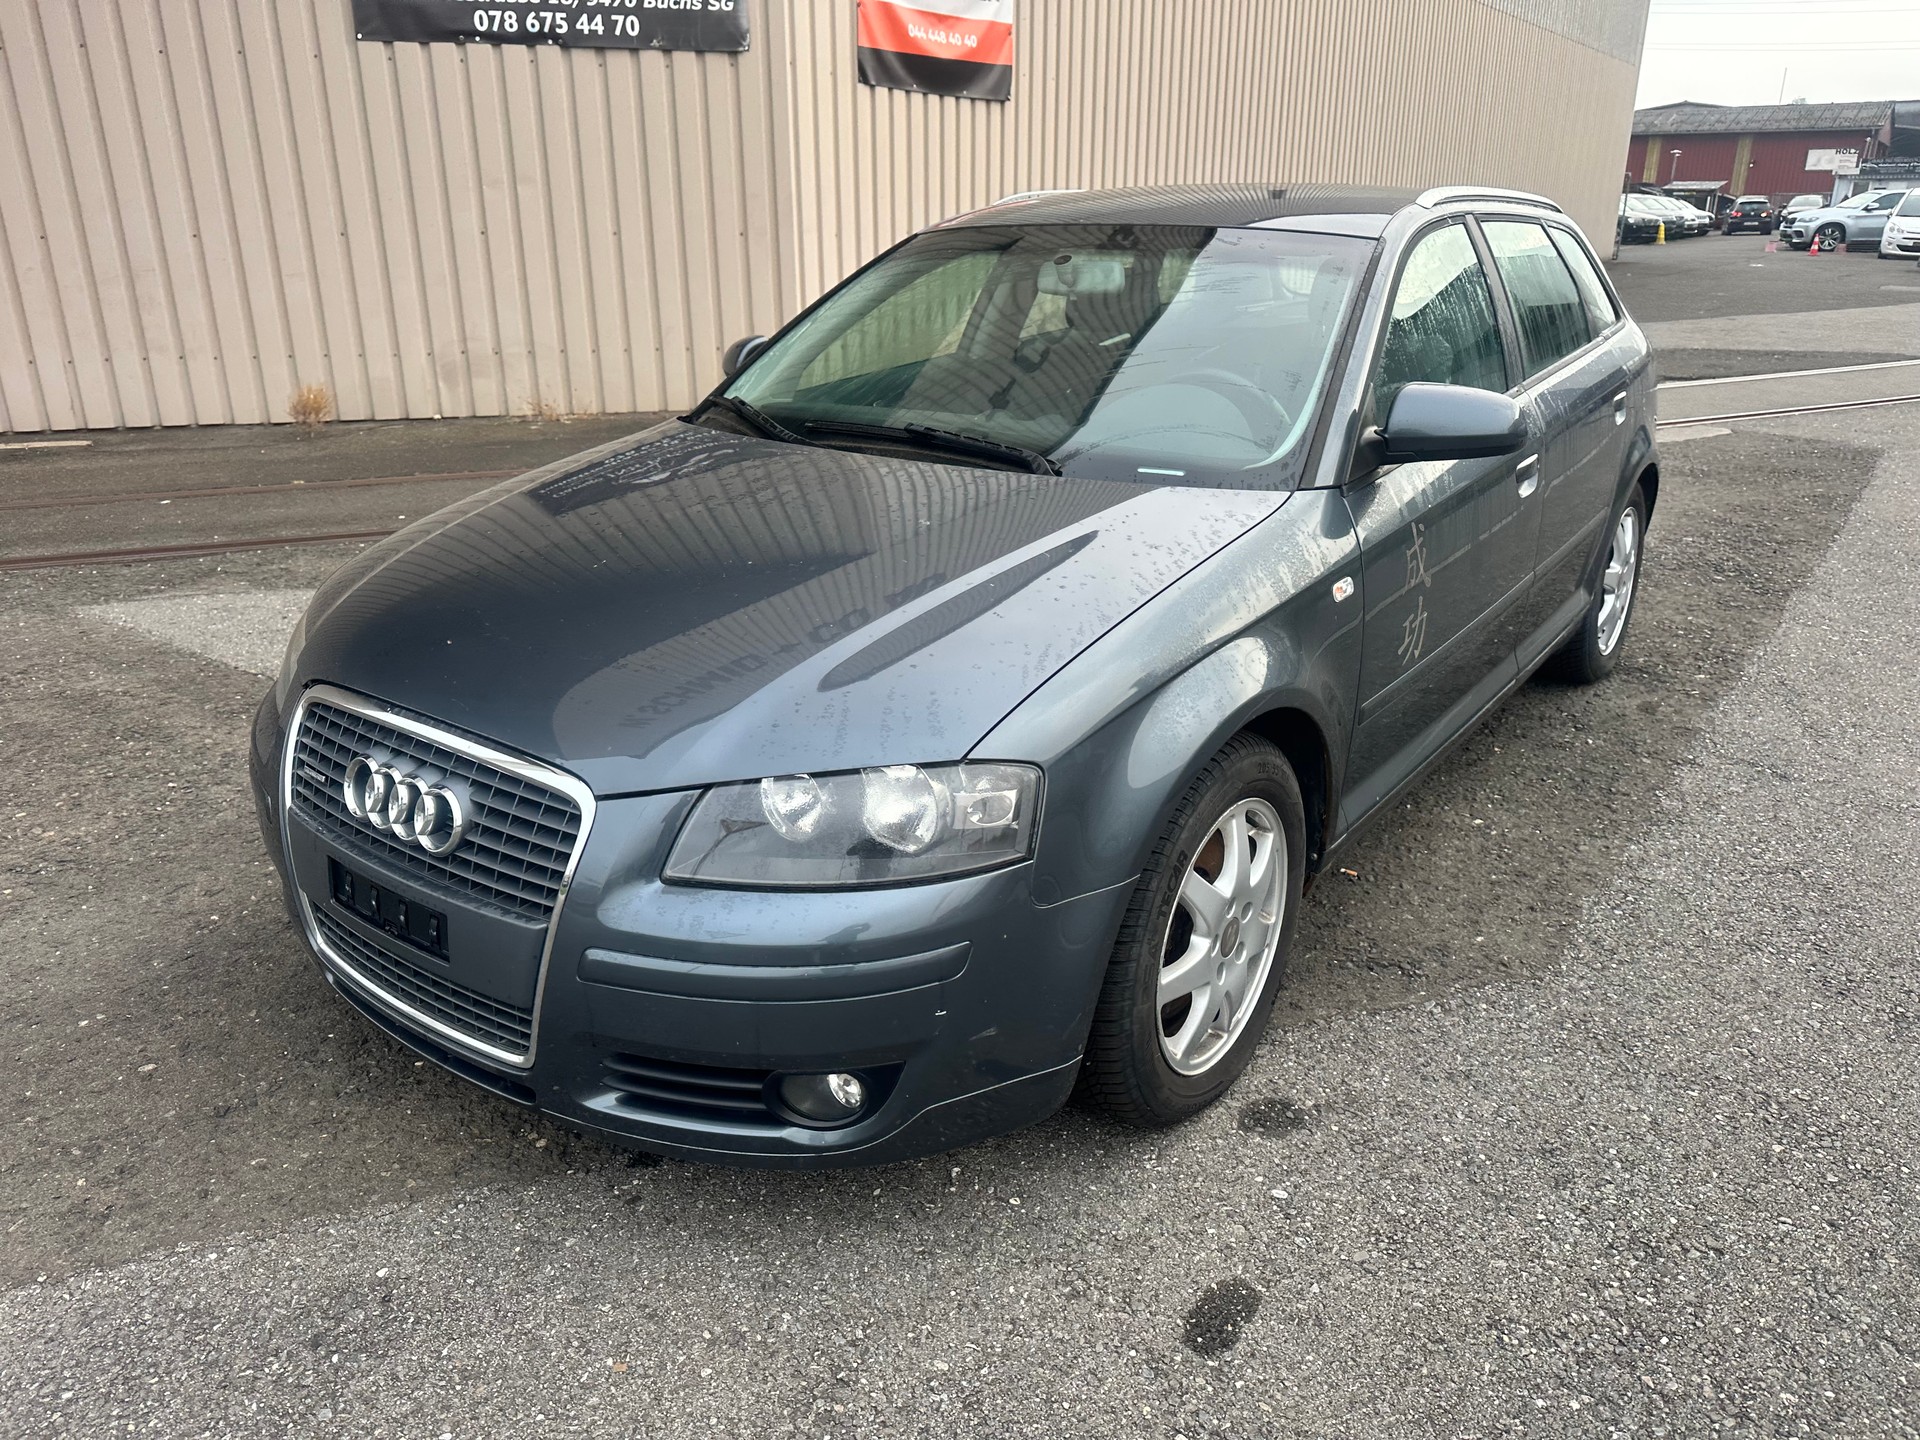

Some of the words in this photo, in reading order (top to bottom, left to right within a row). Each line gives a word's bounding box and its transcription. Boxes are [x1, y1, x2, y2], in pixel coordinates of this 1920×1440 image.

[473, 9, 518, 32] 078
[525, 11, 568, 34] 675
[575, 13, 604, 35] 44
[611, 15, 640, 37] 70
[908, 23, 927, 40] 044
[928, 28, 947, 44] 448
[949, 32, 962, 46] 40
[964, 34, 978, 48] 40
[1398, 521, 1431, 665] 成功
[1156, 850, 1188, 920] TECAR
